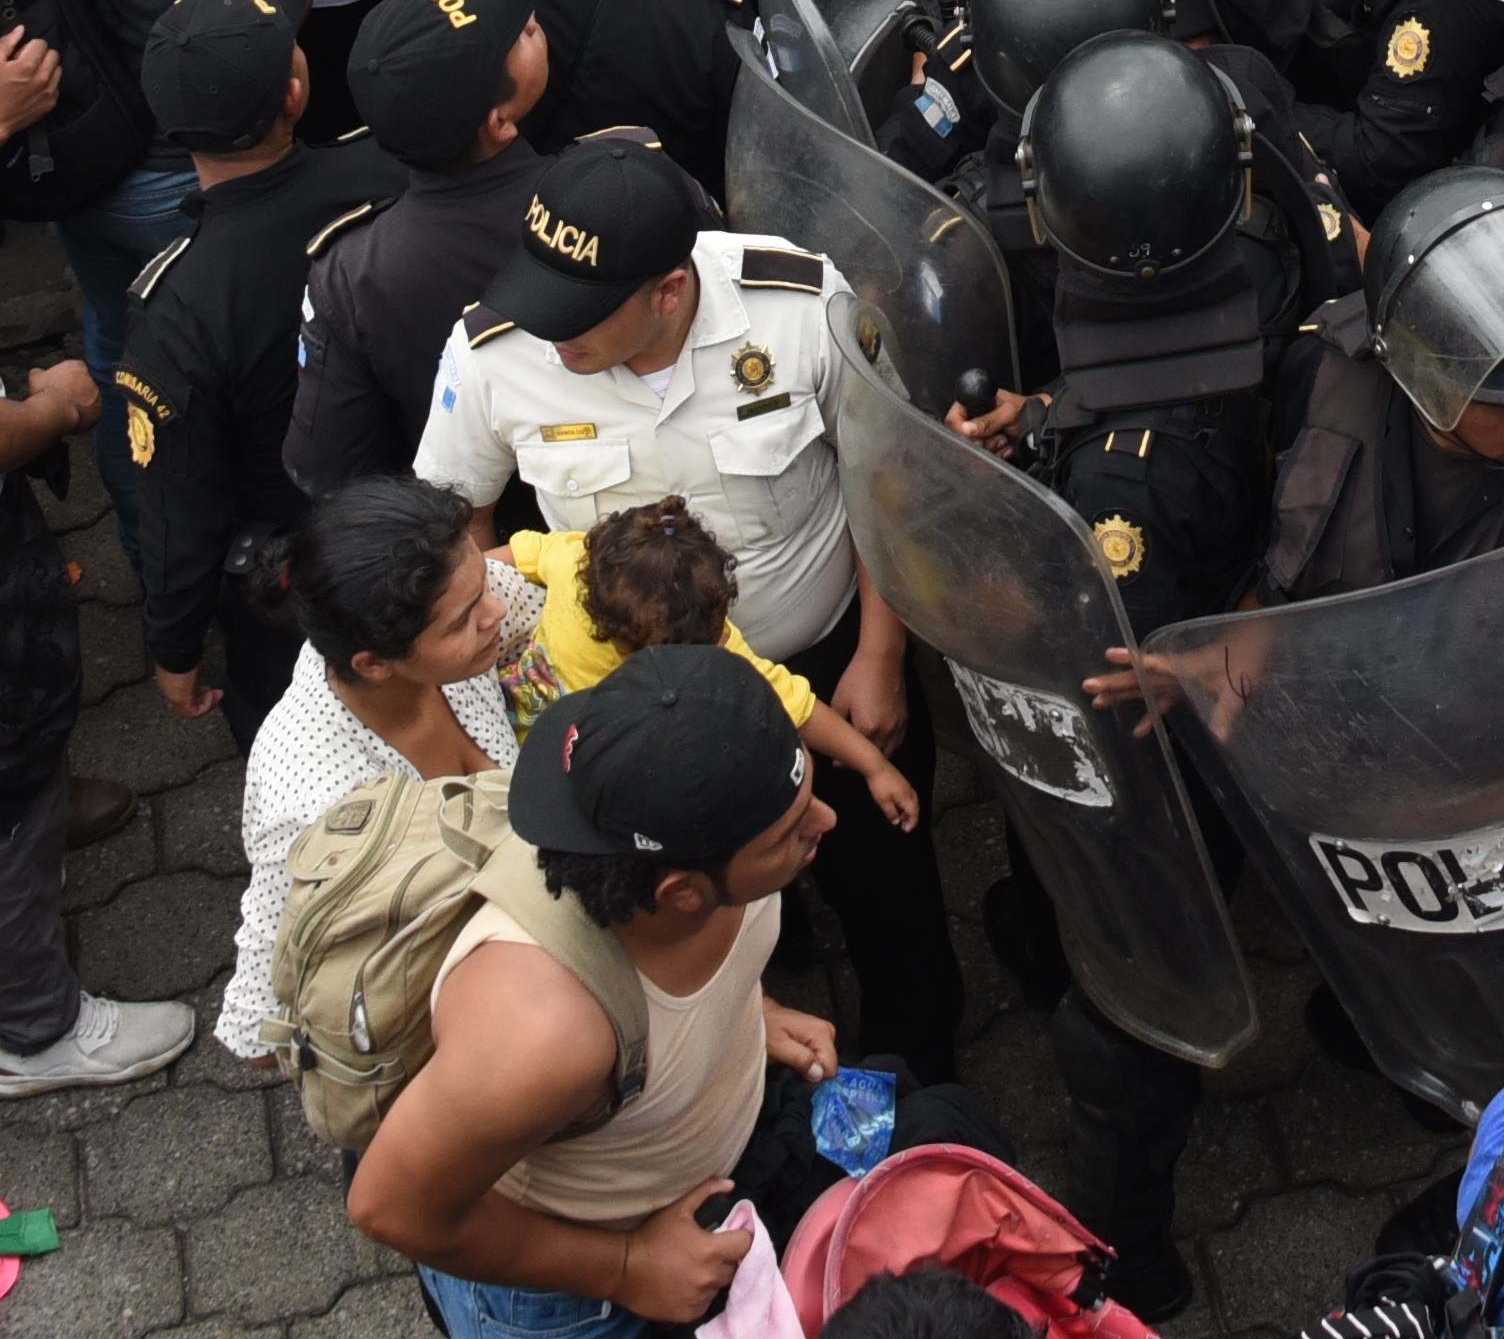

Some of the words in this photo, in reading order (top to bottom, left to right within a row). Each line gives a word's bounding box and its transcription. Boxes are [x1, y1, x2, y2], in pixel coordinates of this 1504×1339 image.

[524, 193, 599, 266] POLICIA
[115, 370, 159, 406] COMISARIA
[157, 403, 171, 419] 42
